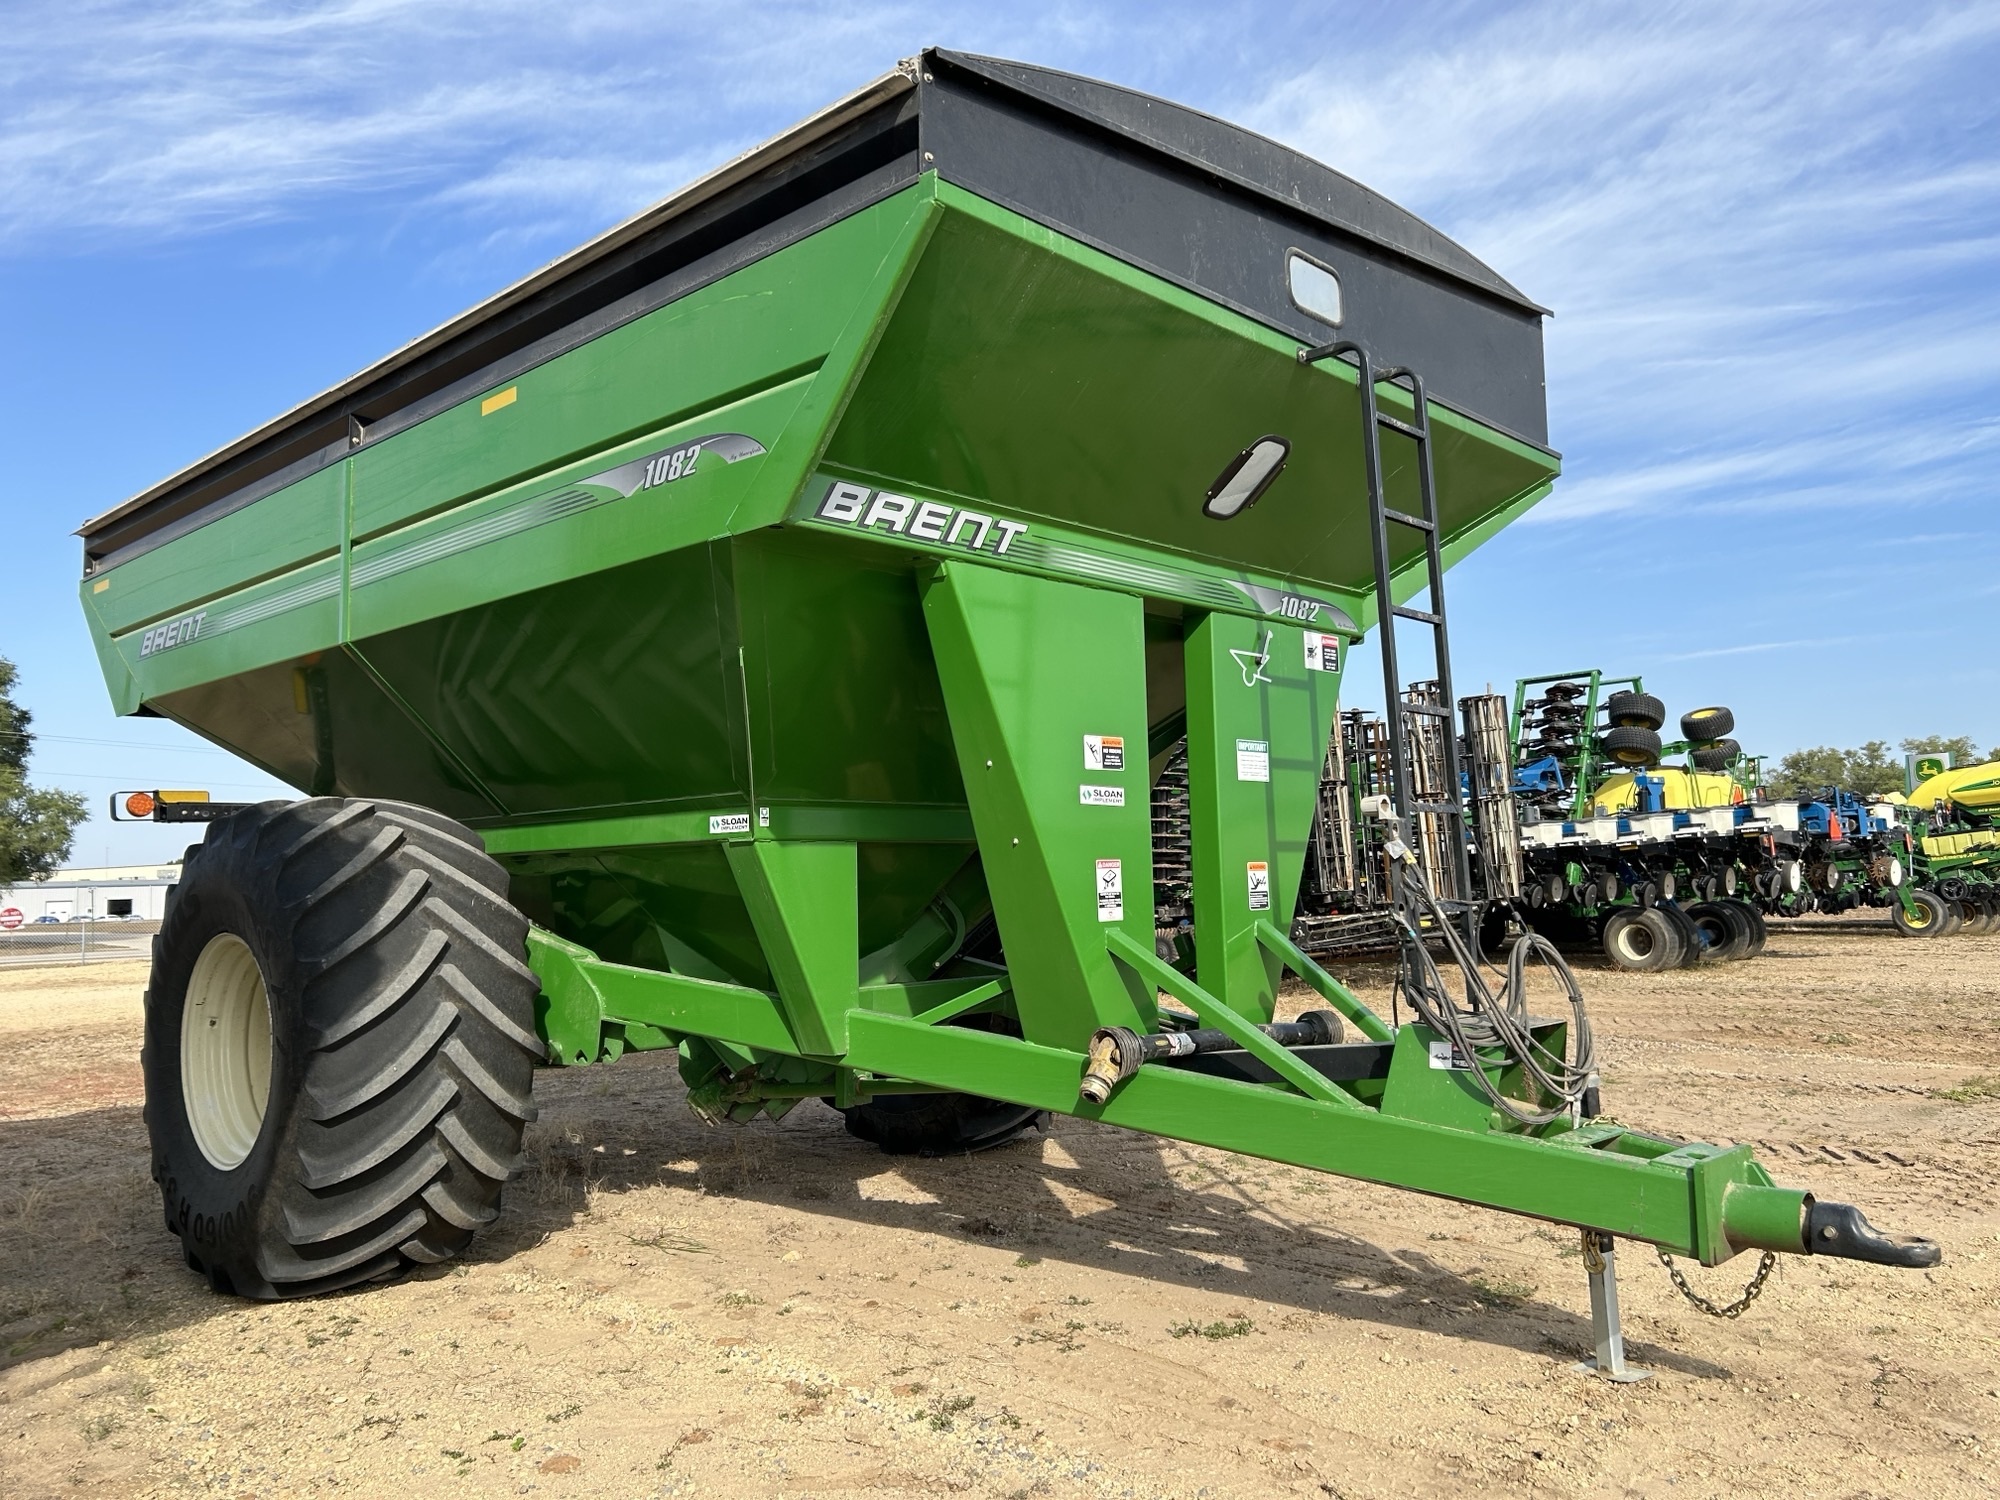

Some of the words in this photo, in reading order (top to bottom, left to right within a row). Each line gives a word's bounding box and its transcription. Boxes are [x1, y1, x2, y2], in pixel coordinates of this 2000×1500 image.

[643, 444, 701, 491] 1082
[816, 480, 1029, 556] BRENT
[1280, 596, 1320, 622] 1082
[140, 611, 207, 657] BRENT
[1238, 742, 1267, 752] IMPORTANT
[1093, 789, 1123, 798] SLOAN
[721, 817, 748, 826] SLOAN
